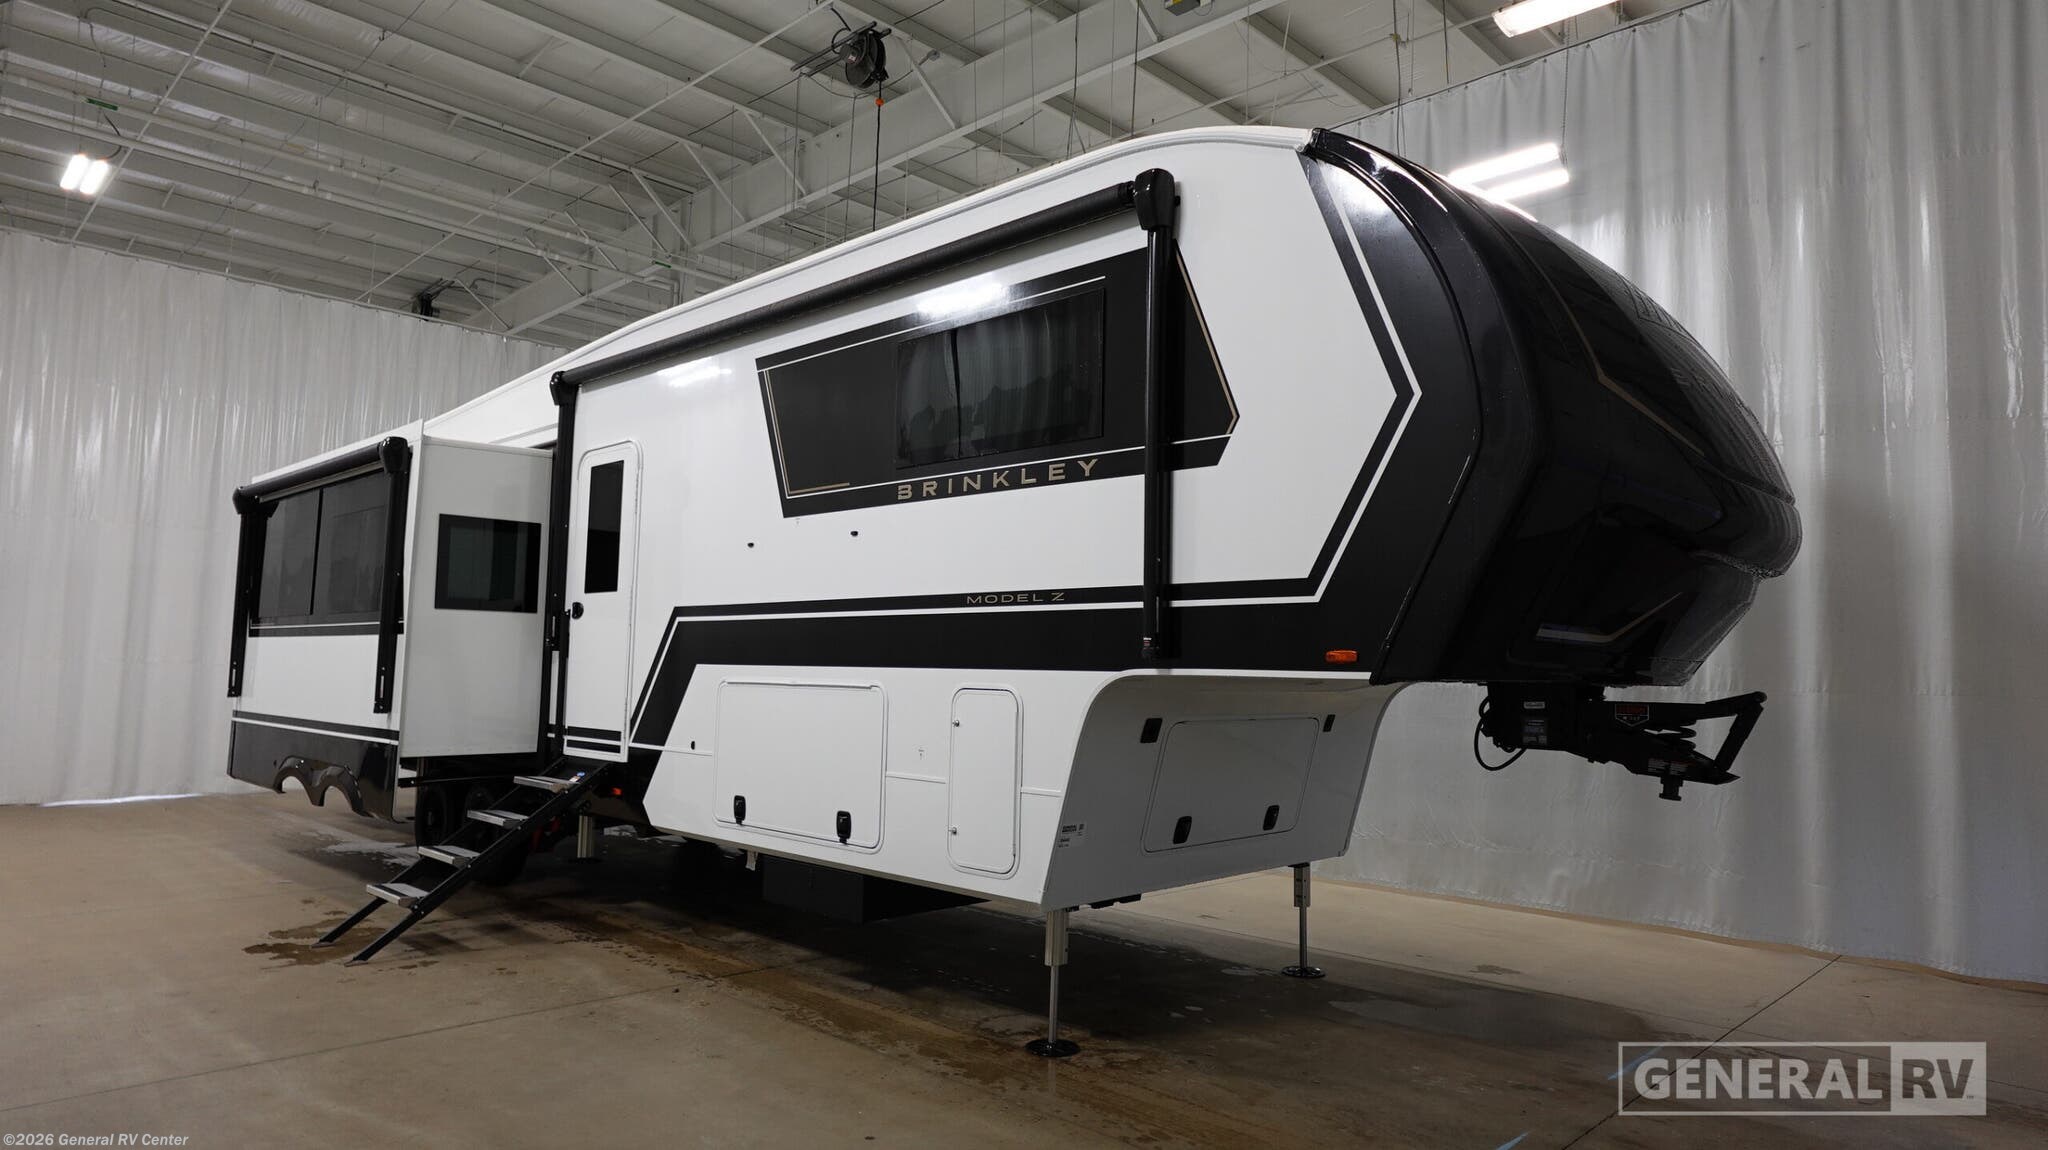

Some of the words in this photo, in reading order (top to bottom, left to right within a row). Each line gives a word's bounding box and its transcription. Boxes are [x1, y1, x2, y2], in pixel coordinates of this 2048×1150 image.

[897, 458, 1098, 500] BRINKLEY
[966, 593, 1043, 605] MODEL
[1052, 592, 1065, 601] Z
